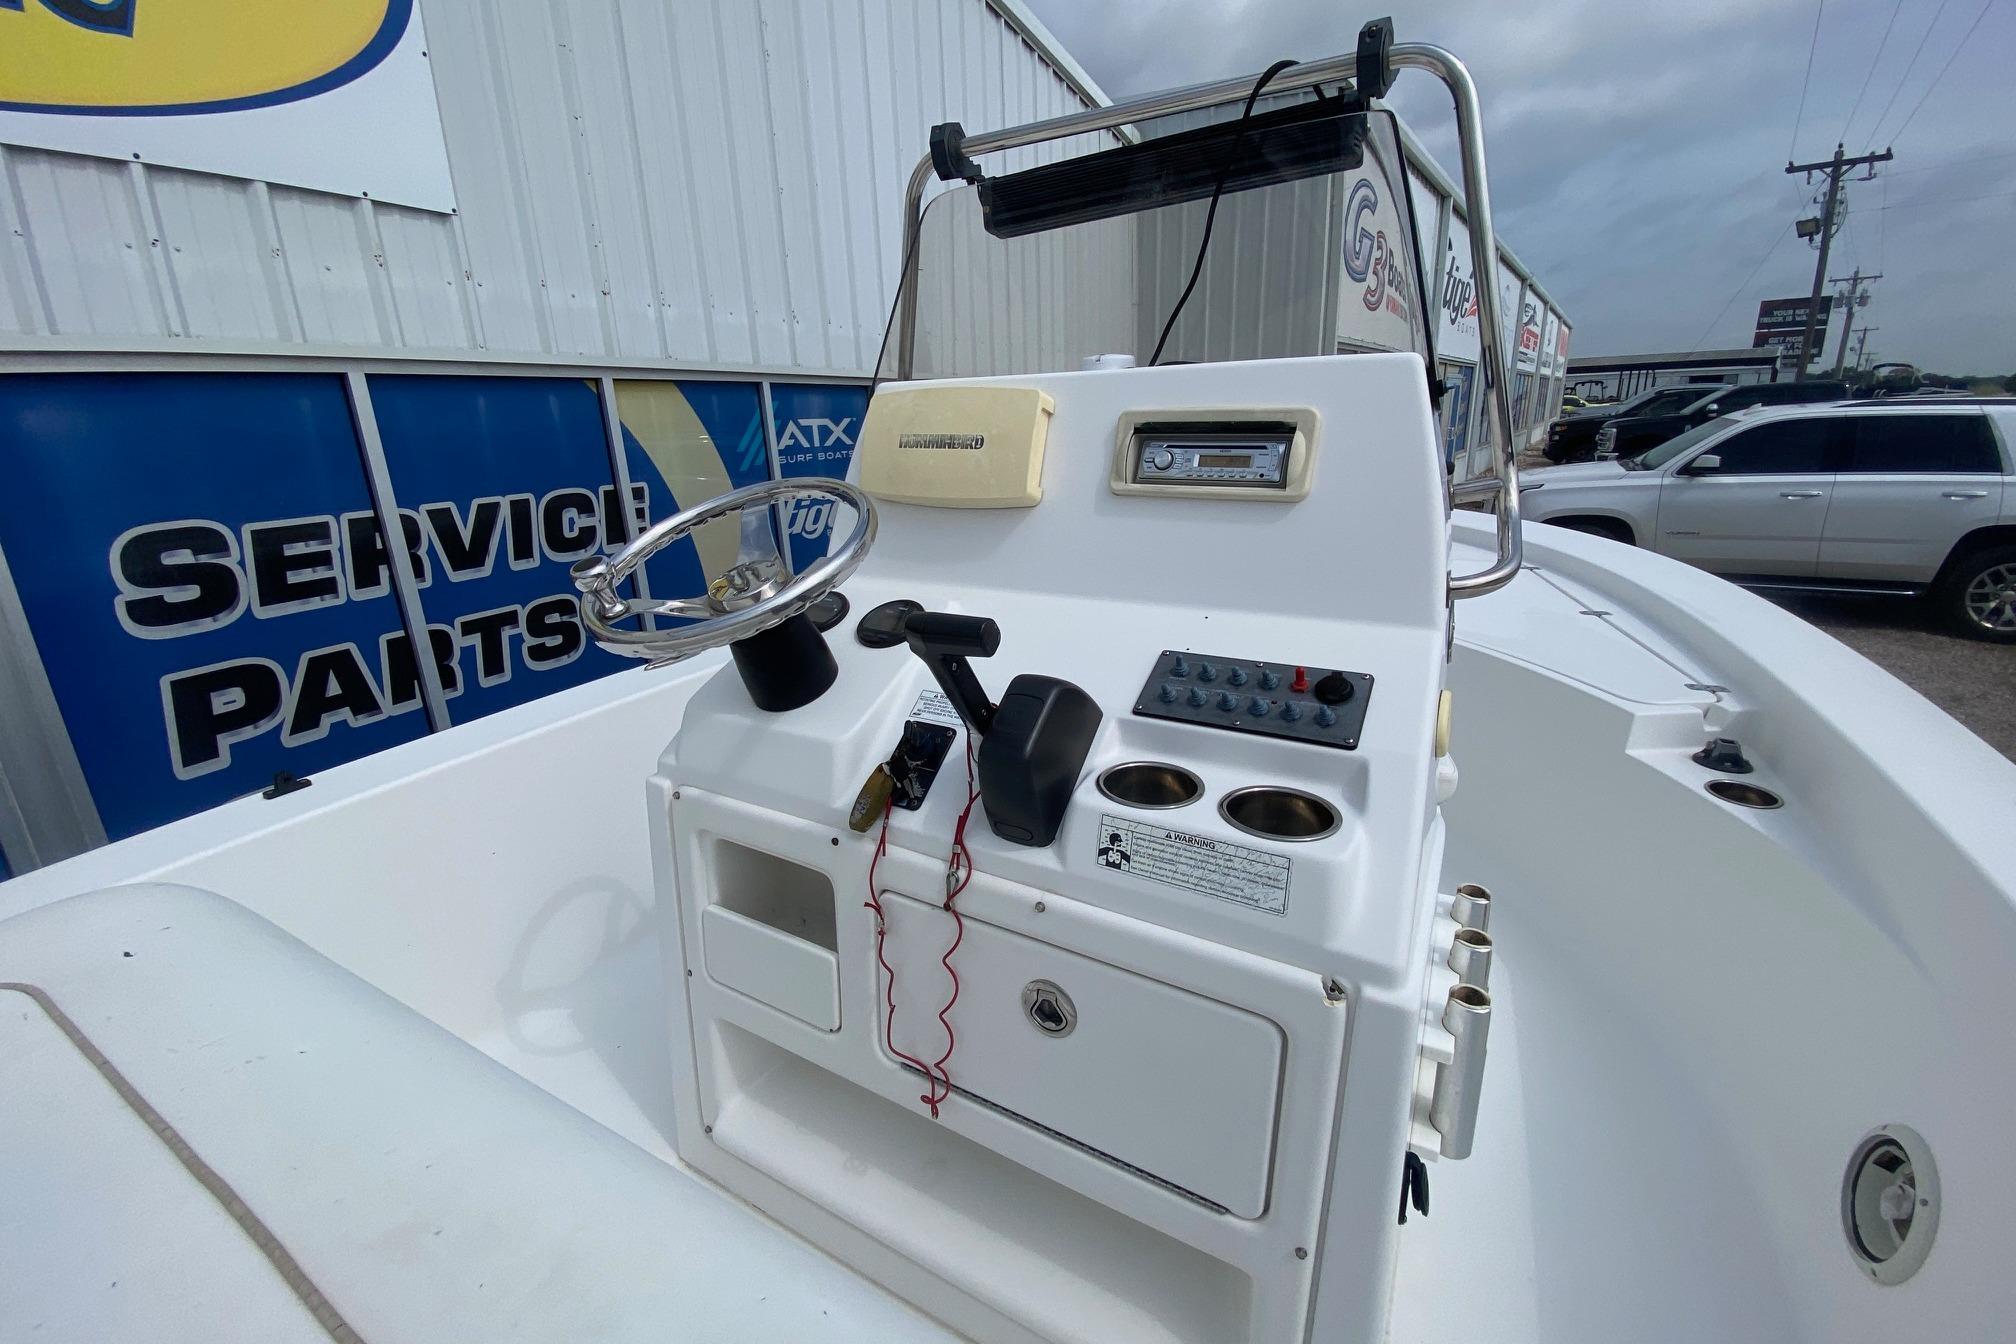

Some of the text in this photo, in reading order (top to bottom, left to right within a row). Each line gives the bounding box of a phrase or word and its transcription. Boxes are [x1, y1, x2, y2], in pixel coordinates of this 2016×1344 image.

[778, 417, 855, 450] ATX
[778, 450, 855, 464] SURF BOATS
[110, 482, 649, 640] SERVICE
[160, 593, 586, 780] PARTS
[1173, 832, 1216, 851] WARNING
